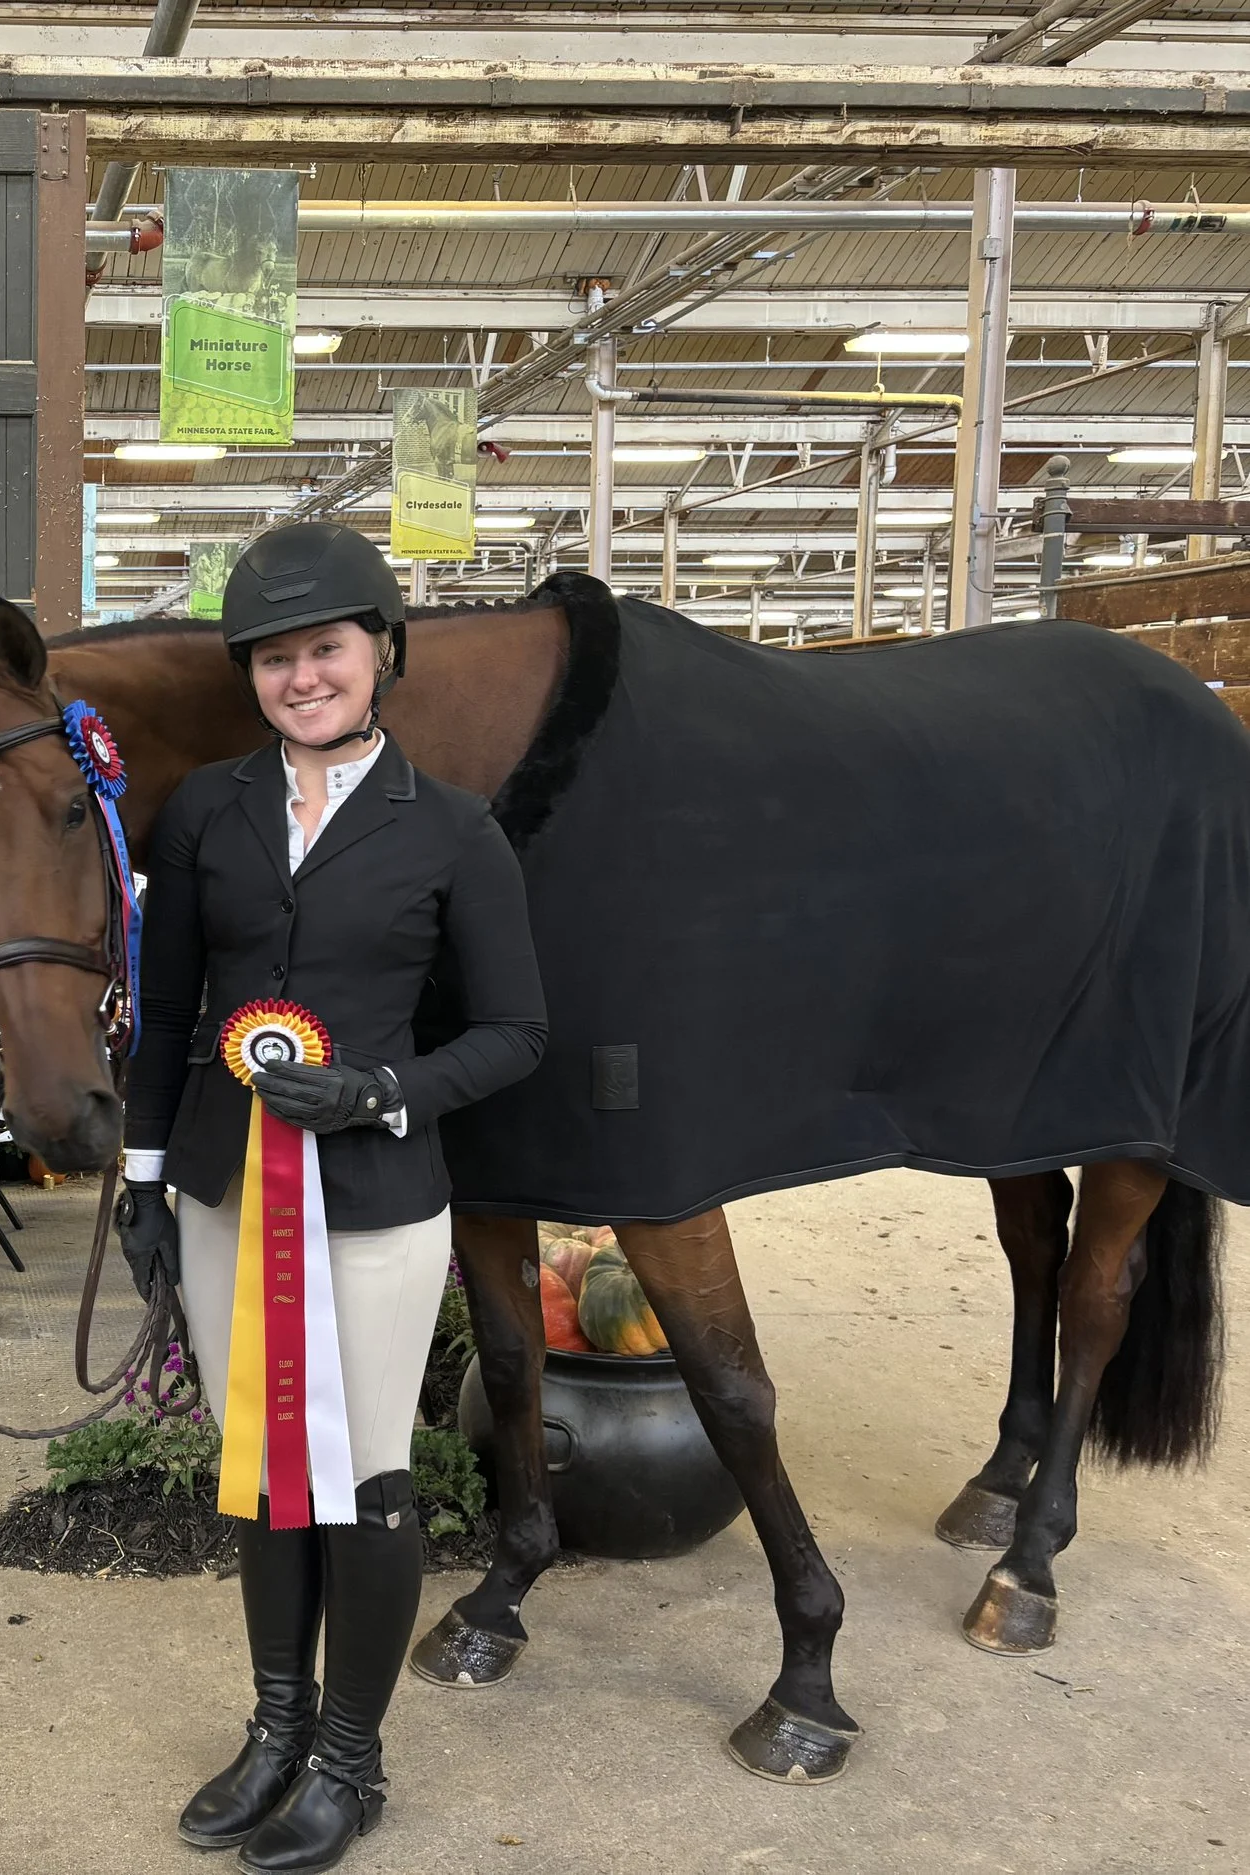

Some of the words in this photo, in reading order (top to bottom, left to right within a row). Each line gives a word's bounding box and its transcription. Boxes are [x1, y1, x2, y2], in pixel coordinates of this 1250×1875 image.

[190, 338, 268, 352] Miniature
[206, 358, 252, 371] Horse
[177, 426, 226, 434] MINNESOTA
[228, 427, 253, 435] STATE
[406, 501, 463, 510] Clydesdale
[272, 1229, 294, 1238] HARVEST
[275, 1250, 292, 1259] HORSE
[276, 1272, 292, 1281] SHOW
[277, 1412, 294, 1421] CLASSIC
